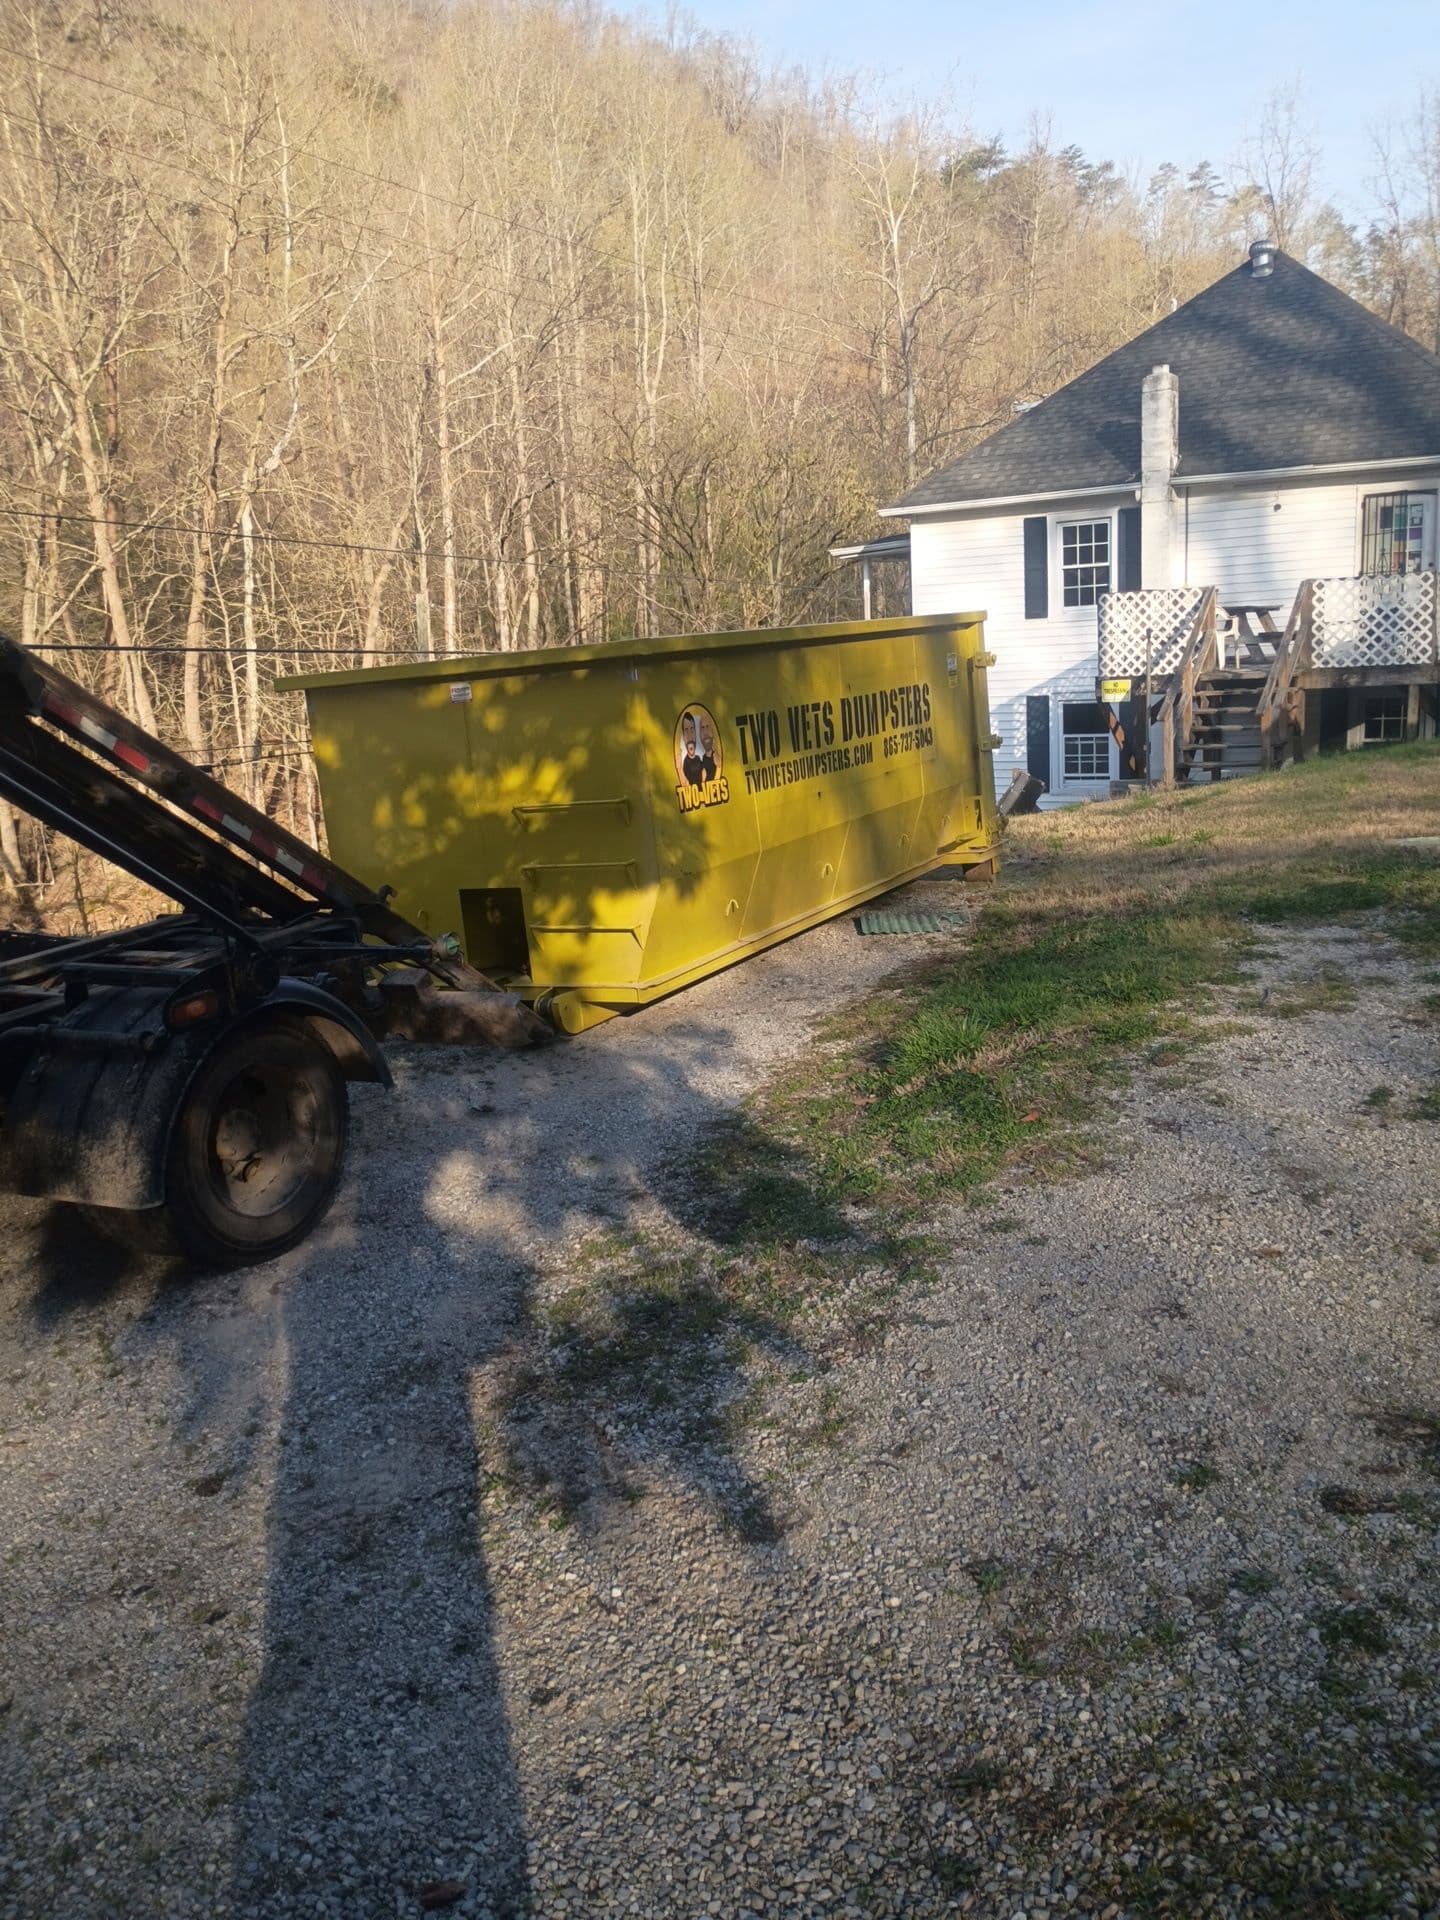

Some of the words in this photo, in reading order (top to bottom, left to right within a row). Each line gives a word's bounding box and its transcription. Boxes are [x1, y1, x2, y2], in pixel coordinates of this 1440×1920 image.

[735, 711, 780, 765] TWO
[787, 700, 835, 753] VETS
[840, 682, 932, 742] DUMPSTERS
[676, 778, 729, 812] TWO-VETS
[744, 741, 874, 795] TWOVETSDUMPSTERS.COM
[883, 726, 933, 759] 865-737-5043
